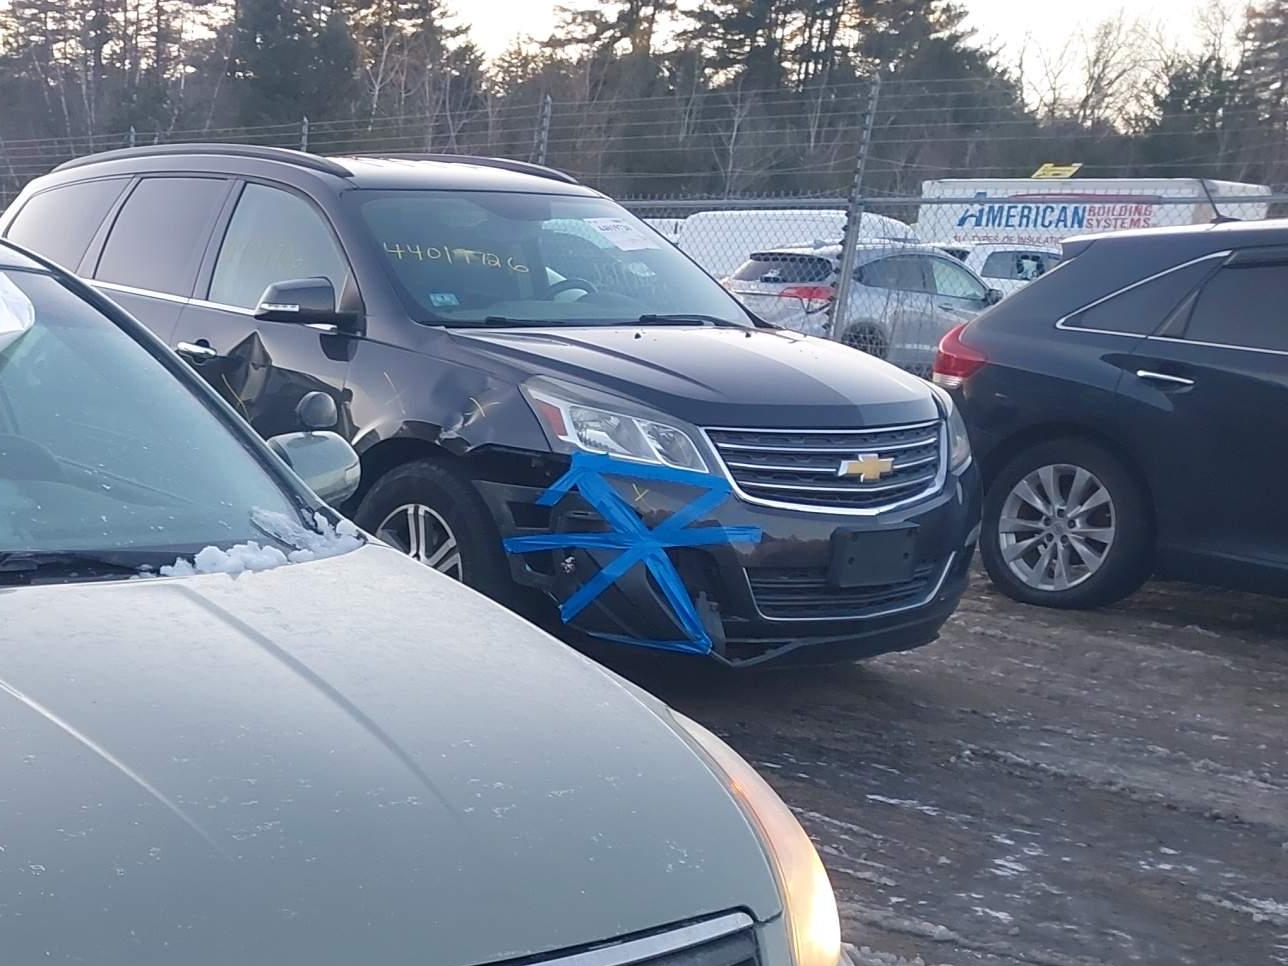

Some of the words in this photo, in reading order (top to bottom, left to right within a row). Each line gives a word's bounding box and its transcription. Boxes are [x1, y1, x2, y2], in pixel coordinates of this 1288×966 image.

[957, 192, 1087, 228] AMERICAN
[1087, 205, 1152, 217] BUILDING
[1086, 217, 1152, 229] SYSTEMS
